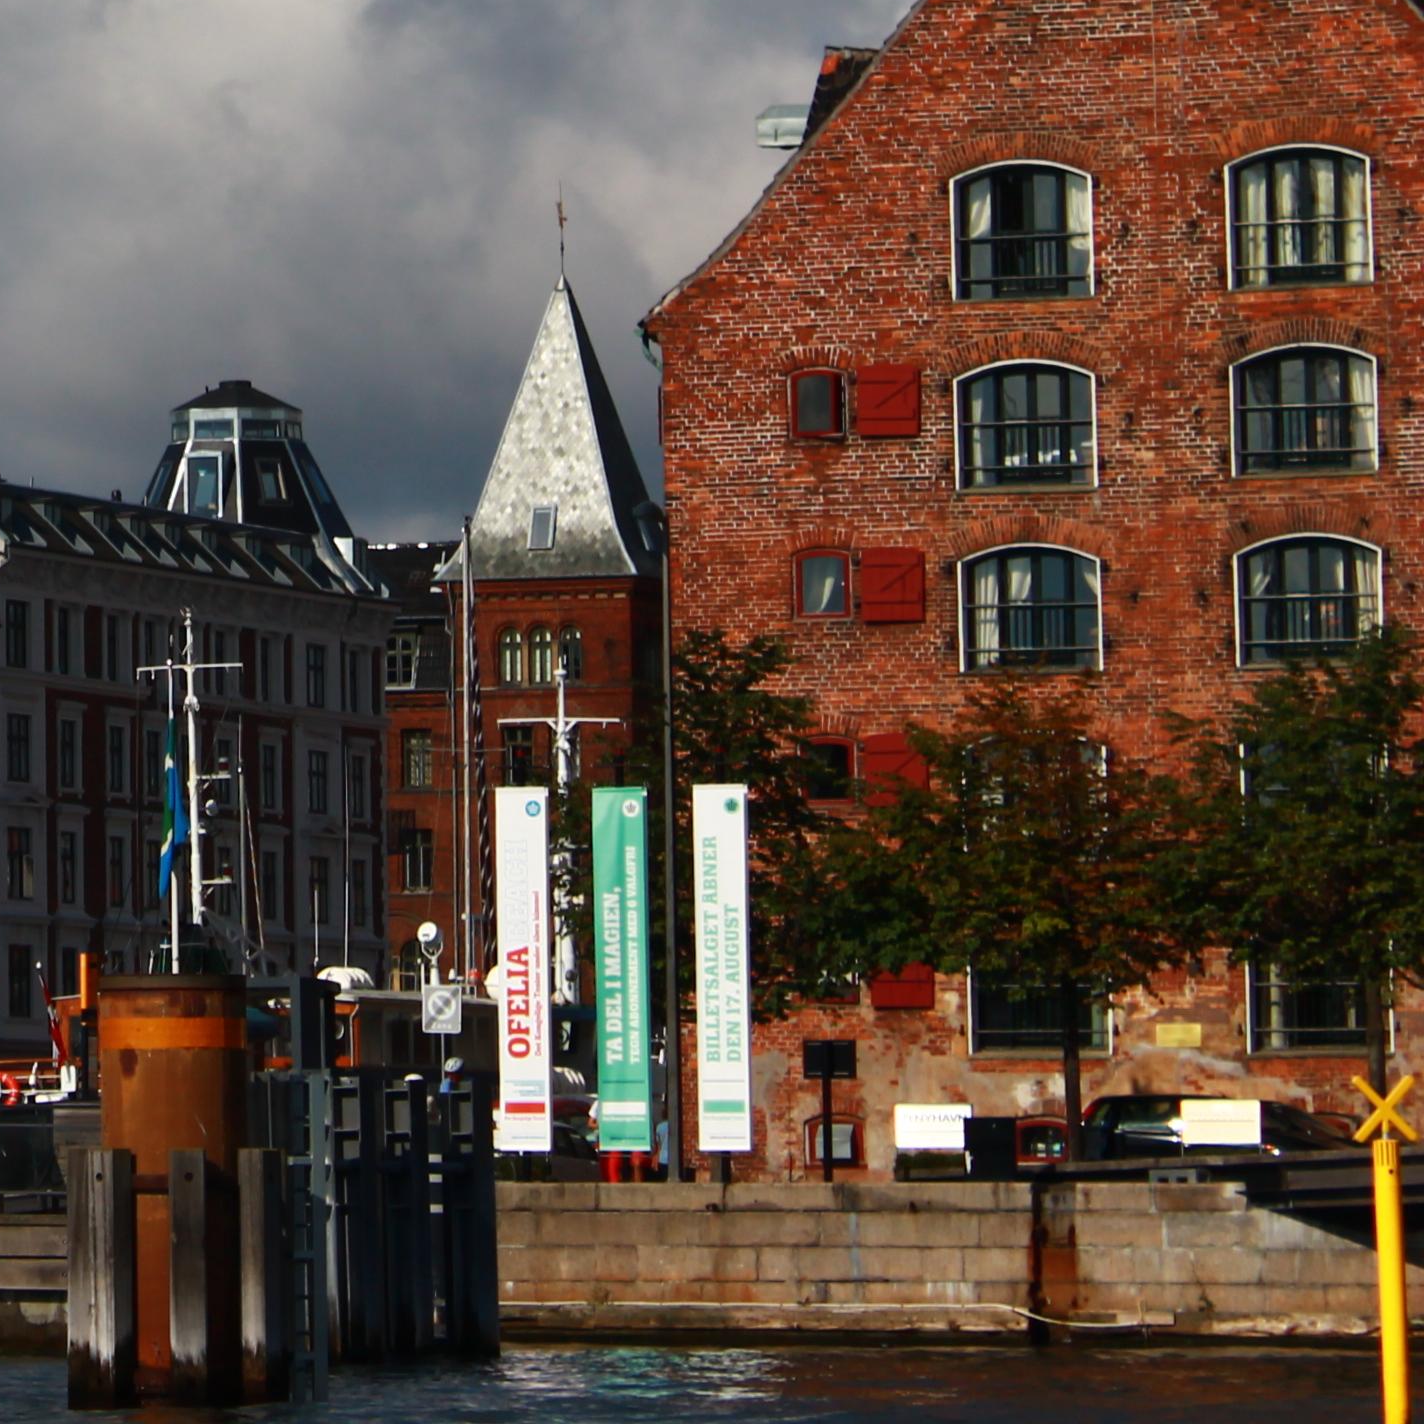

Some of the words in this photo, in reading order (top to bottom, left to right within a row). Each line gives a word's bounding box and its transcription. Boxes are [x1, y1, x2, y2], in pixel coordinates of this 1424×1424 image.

[702, 836, 718, 904] ÅBNER
[603, 886, 623, 977] MAGIEN,
[626, 909, 639, 939] MED
[724, 904, 740, 984] AUGUST
[506, 946, 531, 1059] OFELIA
[605, 981, 622, 989] I
[627, 941, 641, 1030] ABONNEMENT
[703, 910, 720, 1063] BILLETSALGET
[725, 989, 741, 1017] 17.
[605, 993, 624, 1033] DEL
[606, 1037, 624, 1065] TA
[629, 1031, 641, 1065] TEGN
[726, 1020, 741, 1063] DEN
